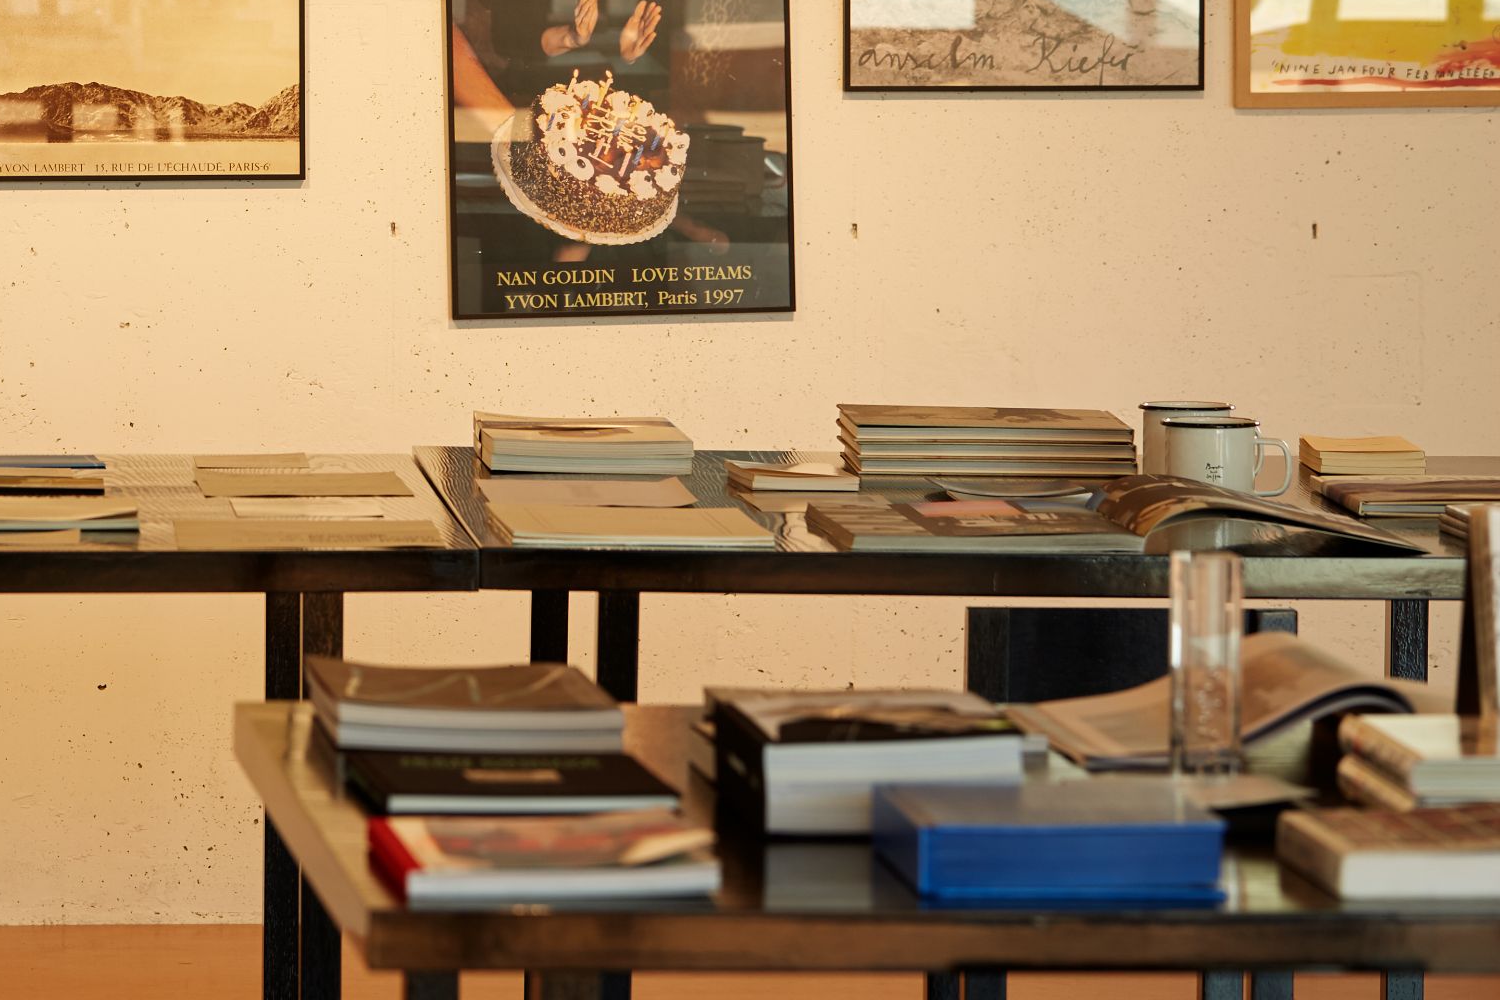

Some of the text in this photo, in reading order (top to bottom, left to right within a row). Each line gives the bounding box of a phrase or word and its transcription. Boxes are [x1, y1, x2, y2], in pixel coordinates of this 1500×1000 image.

[34, 163, 85, 173] LAMBERT
[111, 163, 134, 173] RUE
[138, 163, 154, 173] DE
[496, 265, 752, 287] NAN GOLDIN LOVE STEAMS
[504, 289, 744, 310] YVON LAMBERT, Paris 1997
